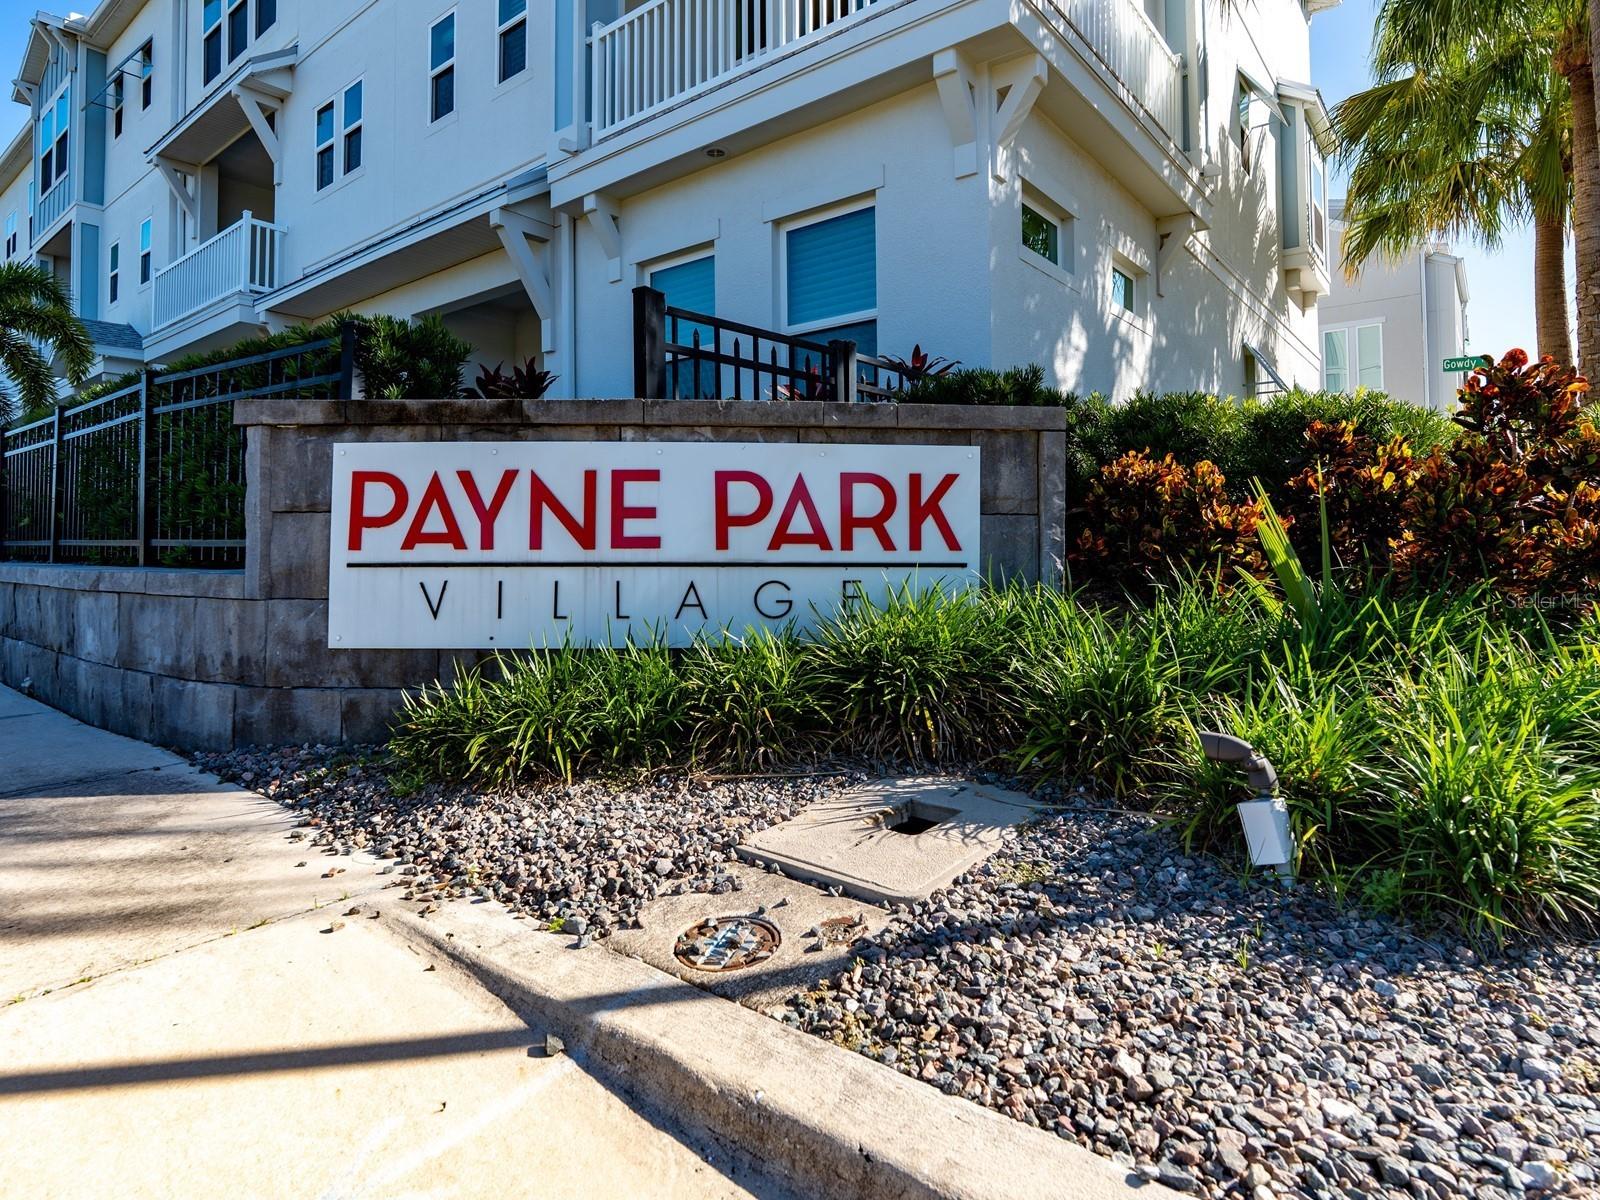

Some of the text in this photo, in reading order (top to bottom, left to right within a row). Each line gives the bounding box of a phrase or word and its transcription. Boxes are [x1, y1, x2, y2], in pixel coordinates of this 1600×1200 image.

[1443, 359, 1476, 369] Gowdy
[347, 469, 961, 552] PAYNE PARK
[419, 579, 862, 620] VILLAGE
